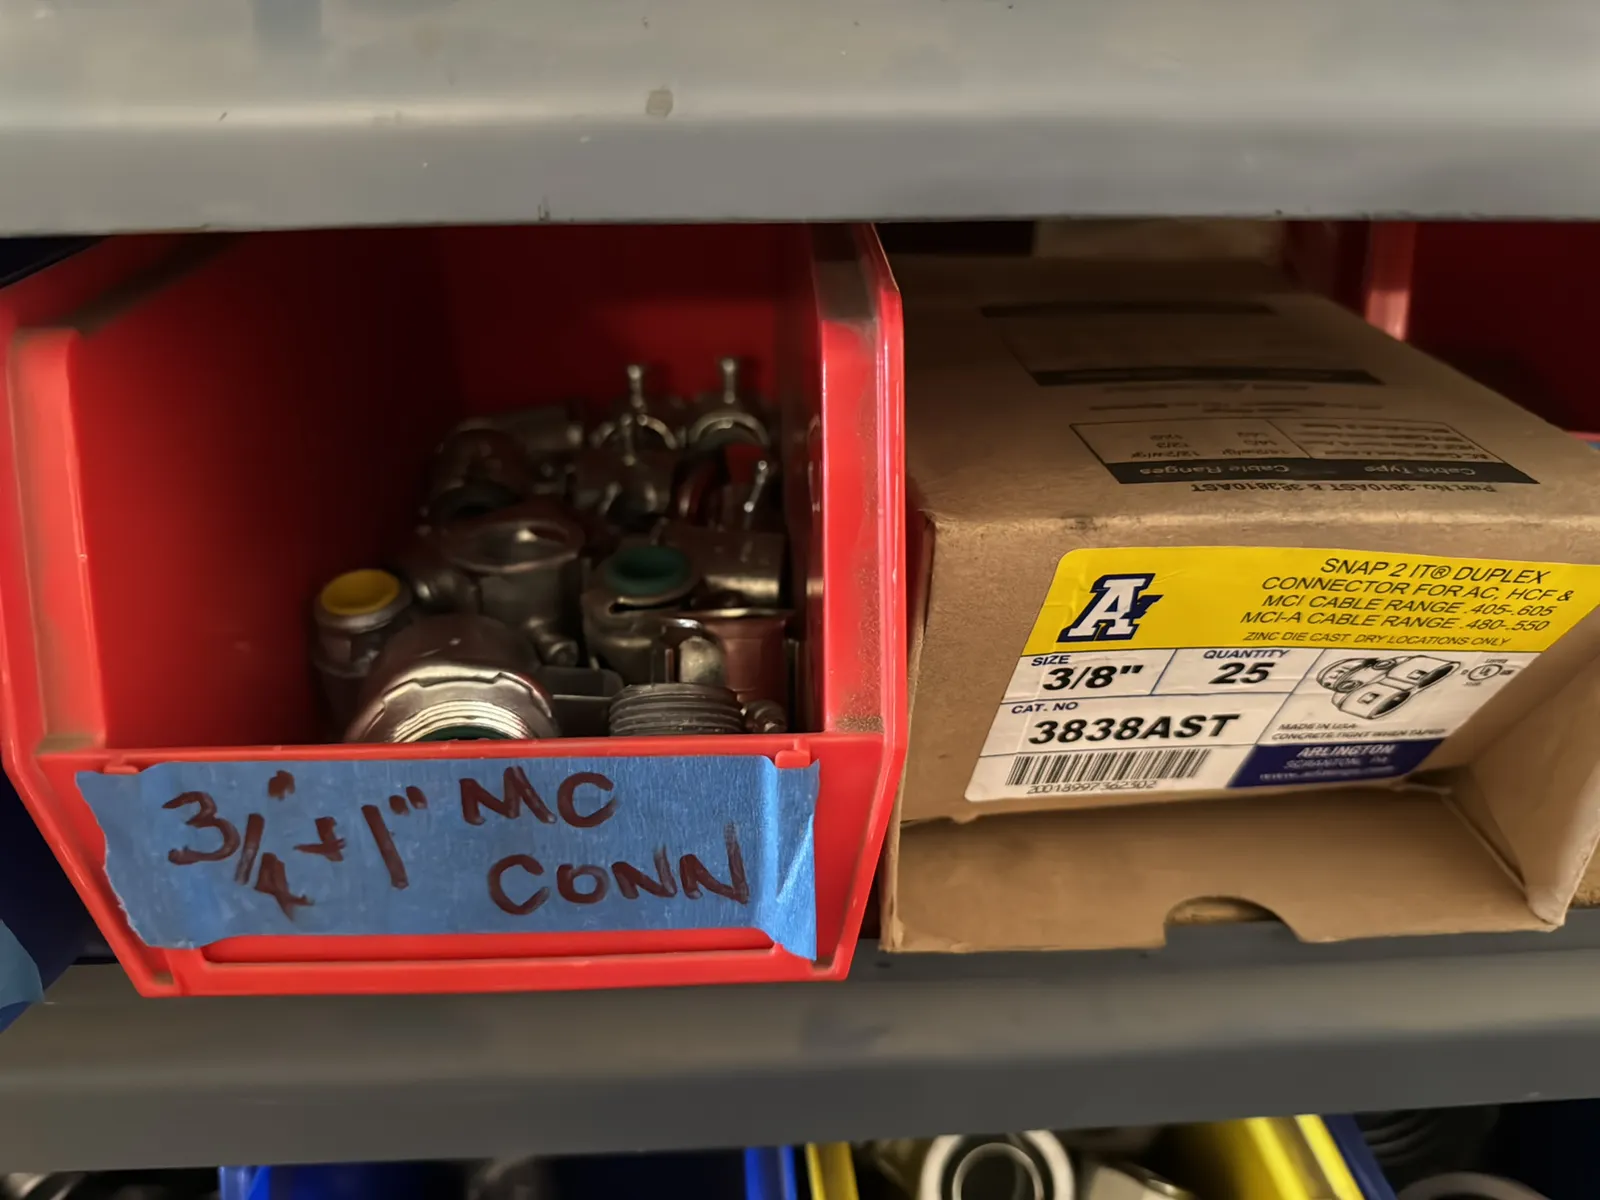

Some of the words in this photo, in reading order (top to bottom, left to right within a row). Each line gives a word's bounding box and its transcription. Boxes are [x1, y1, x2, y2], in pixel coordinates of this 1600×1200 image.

[1139, 465, 1222, 475] Ranges
[1229, 463, 1290, 474] Cable
[1364, 465, 1414, 474] Type
[1418, 466, 1476, 476] Cable
[1320, 558, 1389, 576] SNAP
[1388, 563, 1408, 578] 2
[1452, 566, 1551, 584] DUPLEX
[1262, 576, 1410, 594] CONNECTOR
[1412, 583, 1464, 598] FOR
[1461, 586, 1499, 601] AC,
[1505, 588, 1558, 601] HCF
[1556, 590, 1574, 602] &
[1261, 594, 1307, 608] MCI
[1308, 596, 1383, 611] CABLE
[1384, 599, 1465, 614] RANGE
[1463, 603, 1558, 617] .405-.605
[1240, 611, 1302, 624] MCI-A
[1303, 612, 1380, 627] CABLE
[1380, 616, 1461, 630] RANGE
[1459, 619, 1550, 632] .480-.550
[1242, 631, 1280, 642] ZINC
[1281, 632, 1308, 642] DIE
[1309, 633, 1352, 643] CAST
[1354, 634, 1387, 644] DRY
[1386, 635, 1468, 646] LOCATIONS
[1470, 637, 1512, 647] ONLY
[1031, 654, 1071, 667] SIZE
[1203, 649, 1290, 660] QUANTITY
[1042, 664, 1143, 691] 3/8"
[1208, 661, 1276, 685] 25
[1010, 703, 1050, 715] CAT.
[1052, 701, 1079, 712] NO
[1028, 713, 1240, 746] 3838AST
[1278, 723, 1313, 731] MADE
[1296, 743, 1397, 758] ARLINGTON
[458, 765, 617, 829] MC
[487, 820, 750, 916] CONN
